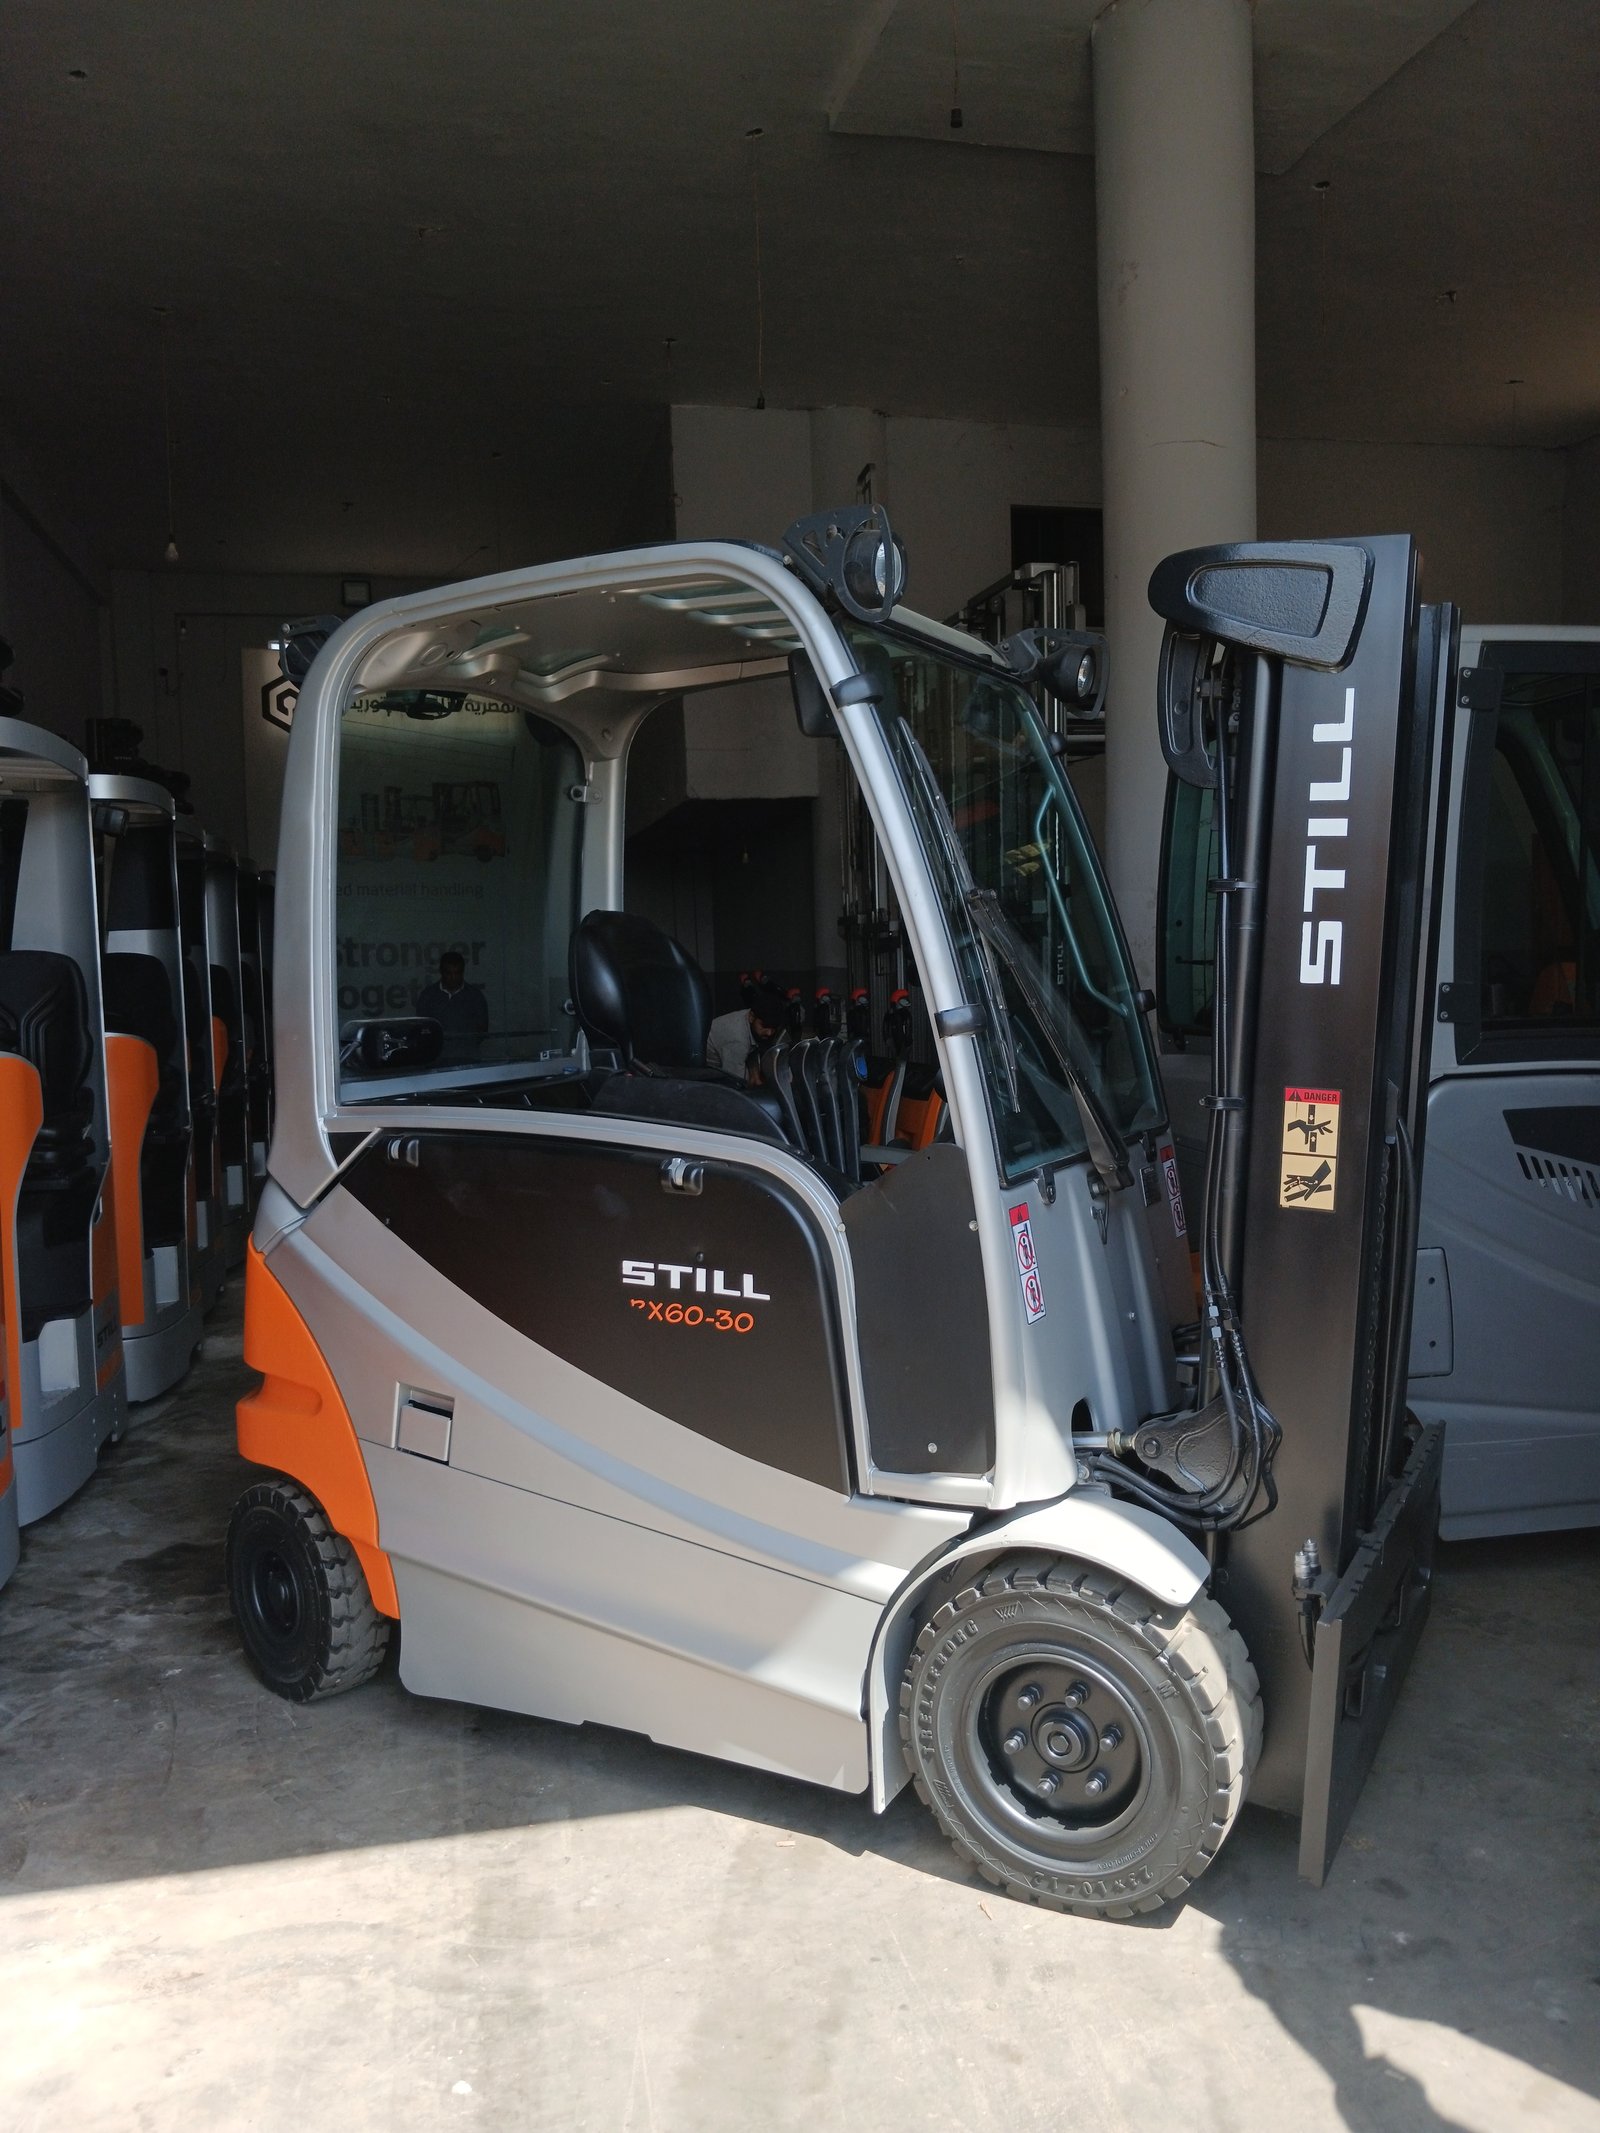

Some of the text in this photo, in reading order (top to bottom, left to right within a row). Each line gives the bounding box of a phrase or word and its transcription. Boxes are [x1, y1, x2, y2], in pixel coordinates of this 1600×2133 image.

[1300, 688, 1355, 985] STILL
[1304, 1091, 1338, 1102] DANGER
[622, 1260, 771, 1301] STILL
[919, 1619, 979, 1762] TRELLEBORG
